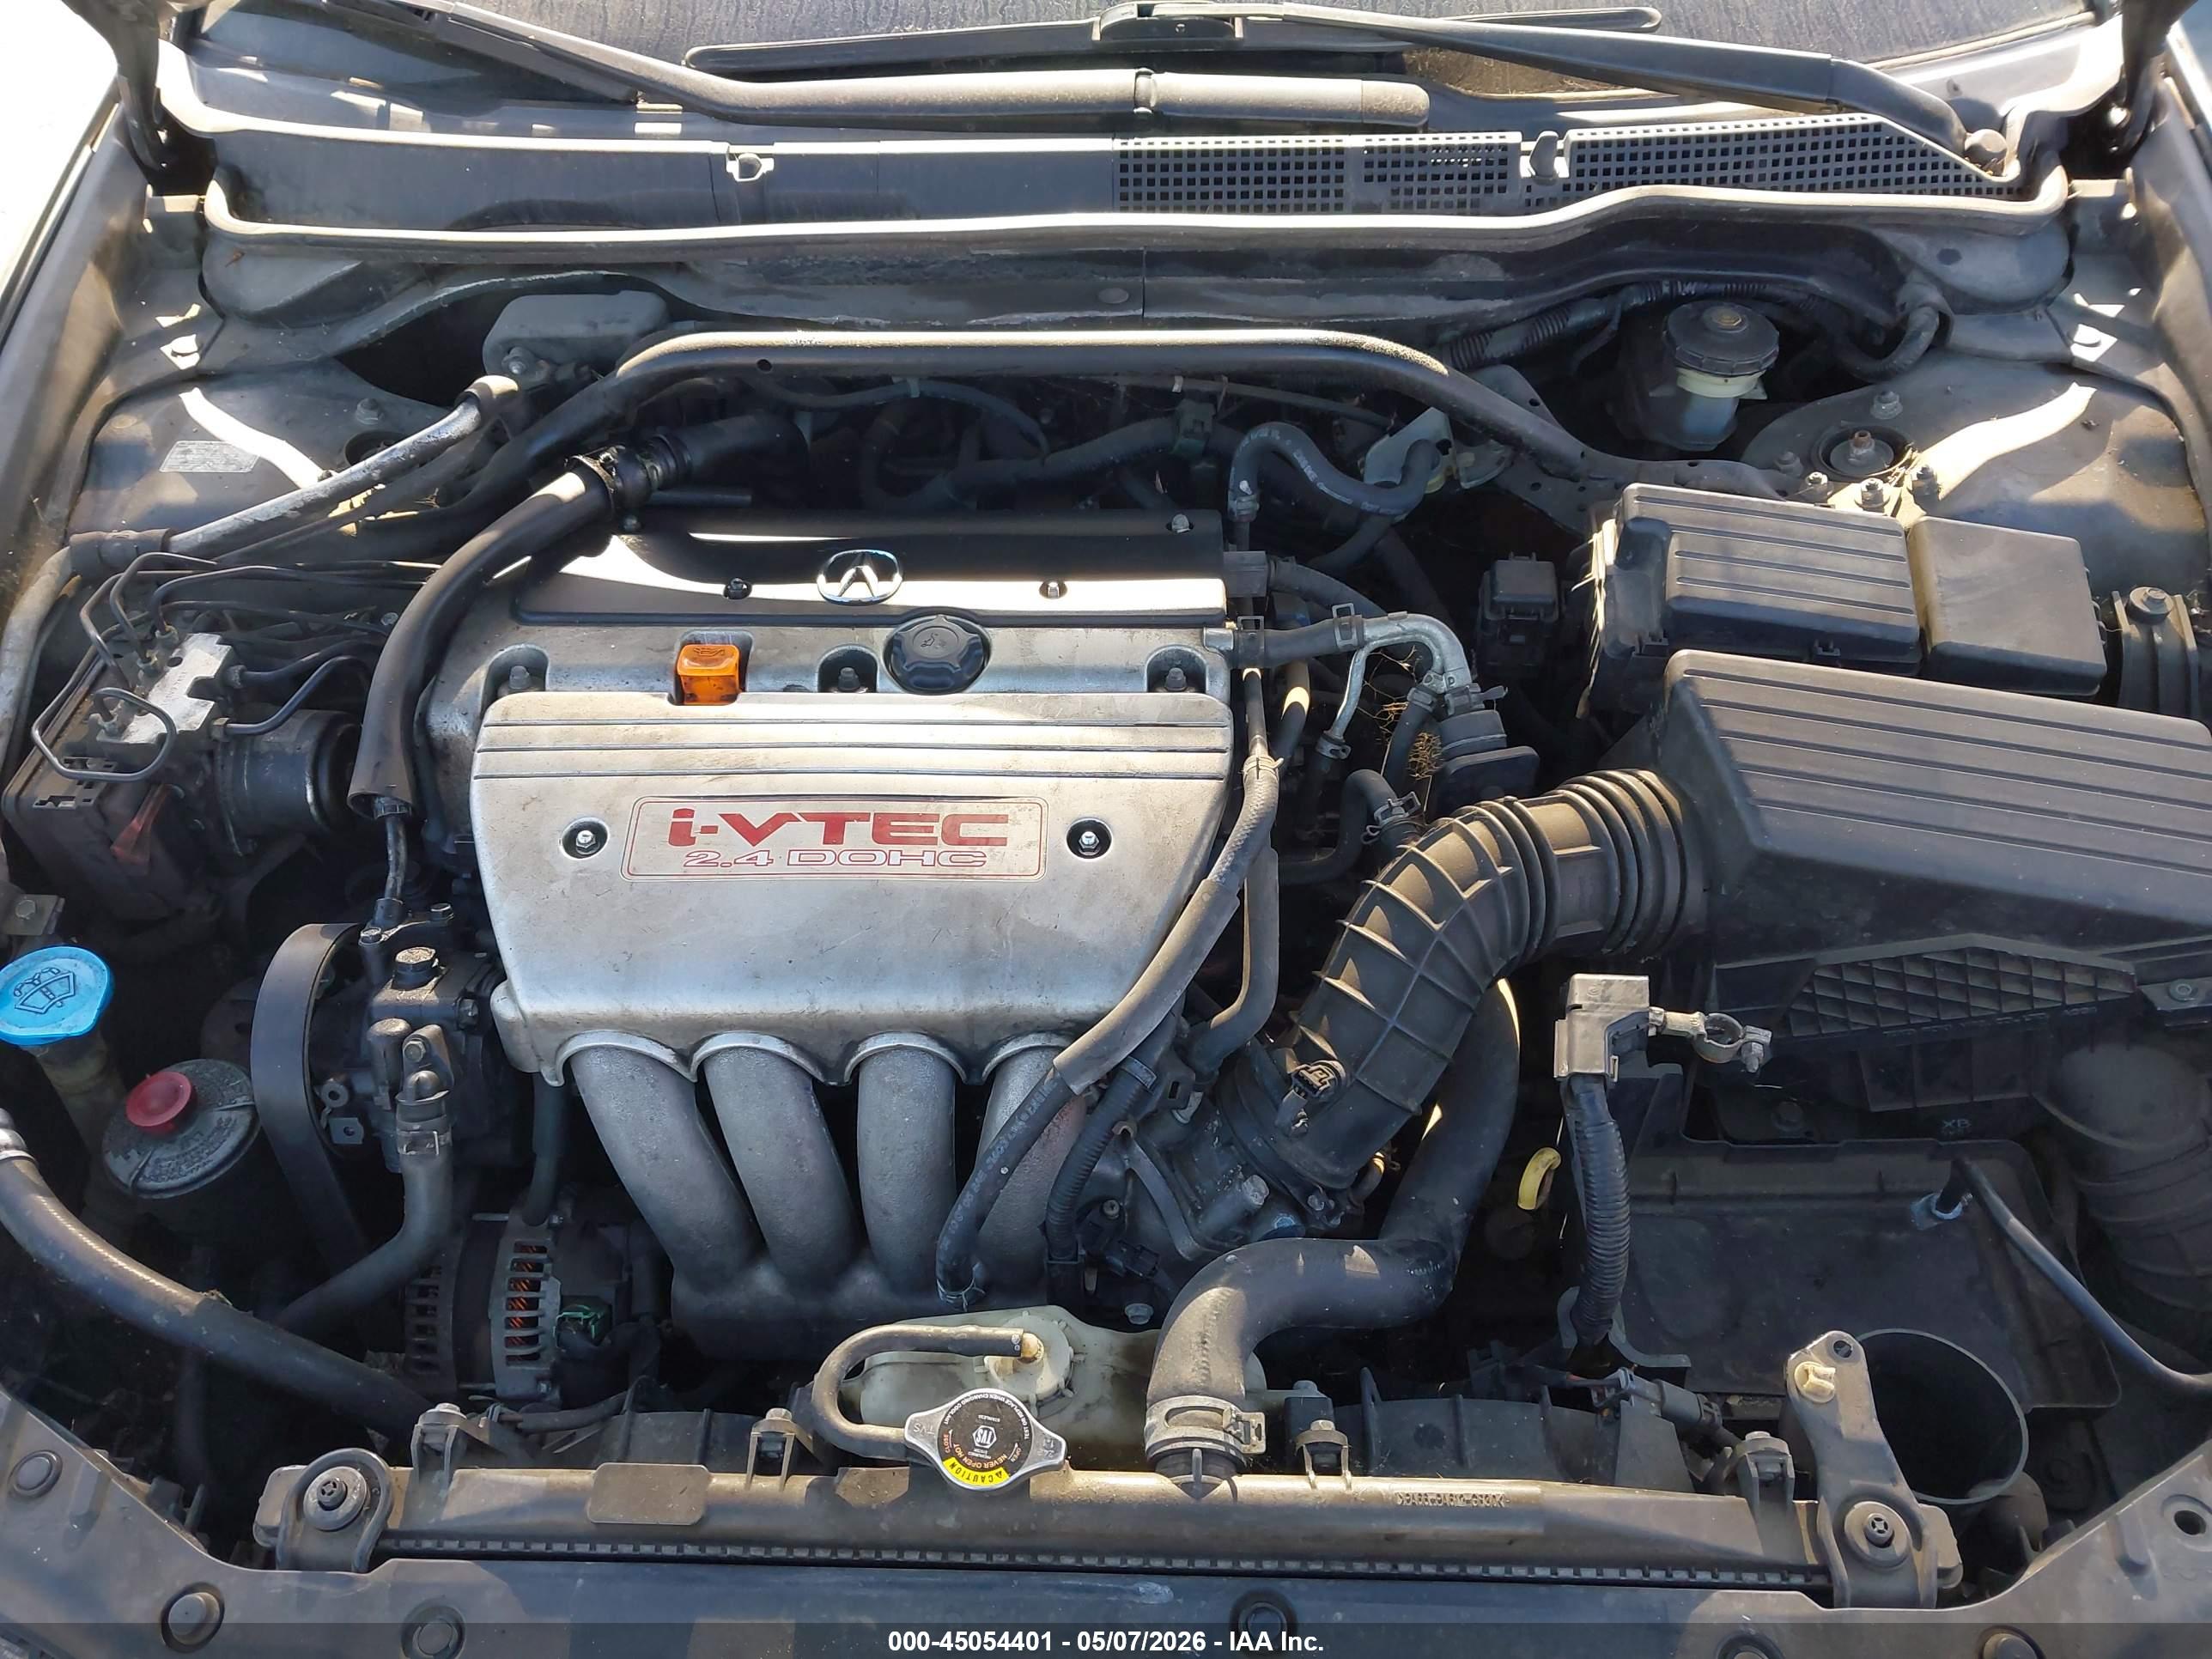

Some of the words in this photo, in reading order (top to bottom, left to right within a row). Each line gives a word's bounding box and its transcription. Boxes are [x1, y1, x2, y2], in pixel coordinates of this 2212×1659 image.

[667, 807, 1010, 848] i-VTEC
[683, 850, 775, 869] 2.4
[786, 849, 988, 868] DOHC
[914, 1422, 935, 1437] TVS
[976, 1430, 992, 1444] TVS
[953, 1443, 964, 1460] HOT
[1011, 1448, 1022, 1462] OPEN
[963, 1455, 982, 1468] OPEN
[983, 1454, 1007, 1468] NEVER
[948, 1462, 994, 1484] CAUTION
